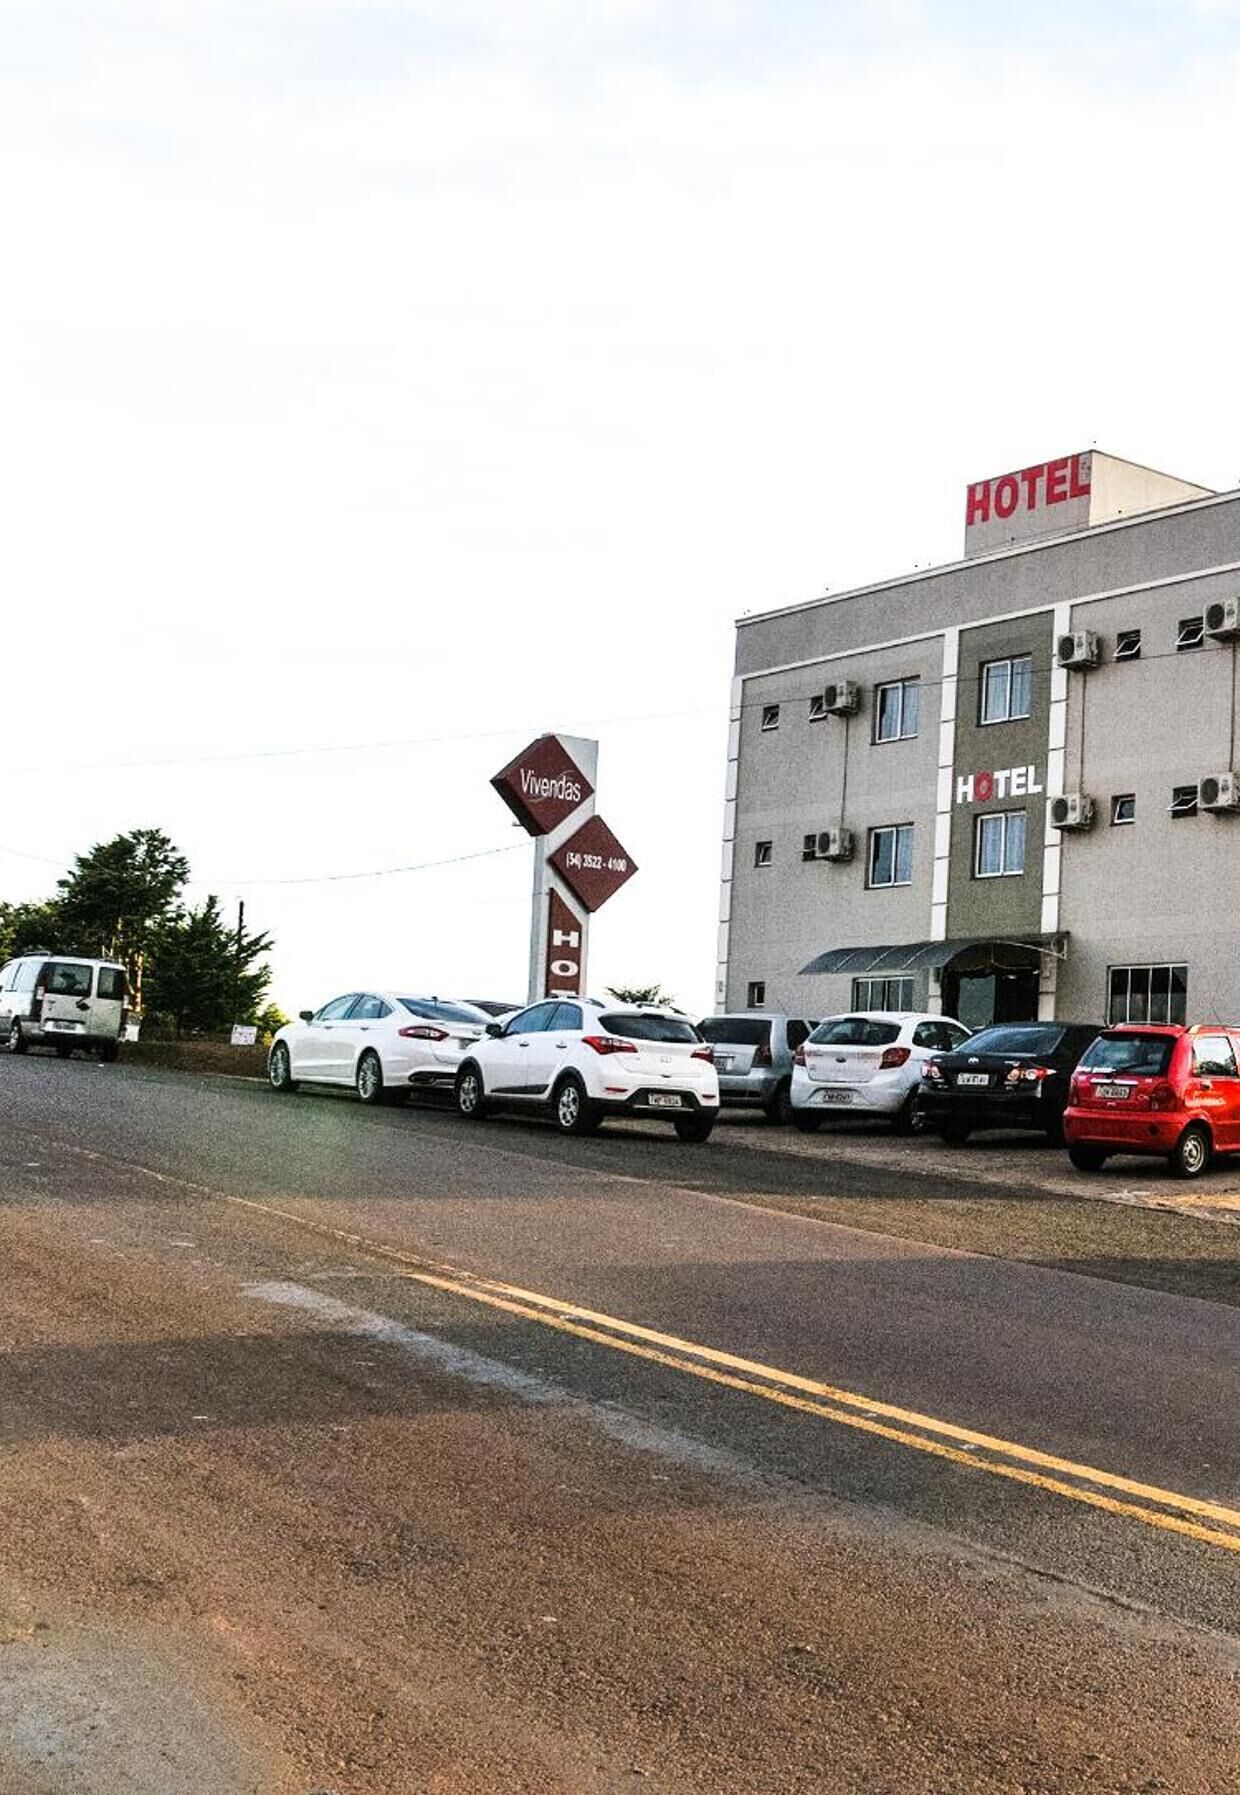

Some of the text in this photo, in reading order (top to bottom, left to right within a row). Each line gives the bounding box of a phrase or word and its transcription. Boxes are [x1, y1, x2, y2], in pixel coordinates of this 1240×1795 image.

[967, 453, 1091, 526] HOTEL
[520, 768, 581, 802] Vivendas
[956, 765, 1043, 804] HOTEL
[583, 854, 602, 870] 3522
[551, 929, 579, 995] HO
